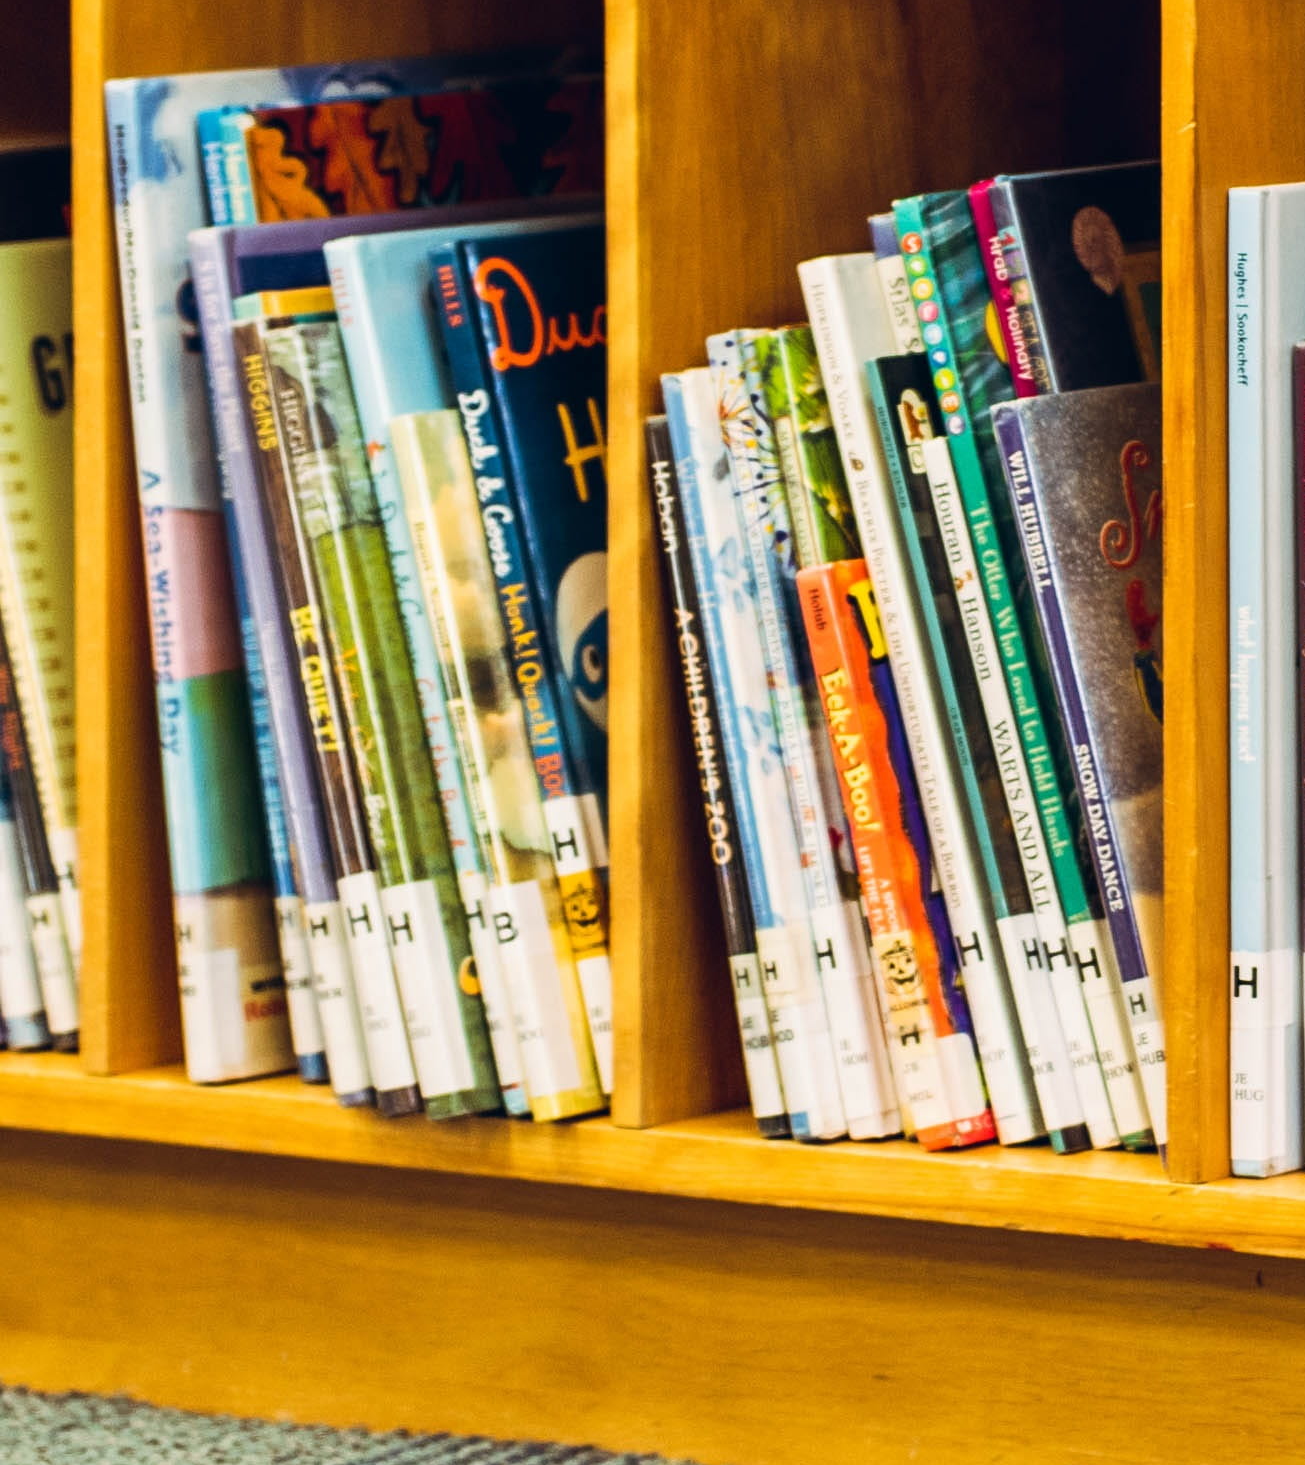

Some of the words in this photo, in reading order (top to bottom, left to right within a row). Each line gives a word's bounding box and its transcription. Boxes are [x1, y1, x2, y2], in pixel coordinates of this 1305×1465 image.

[243, 354, 275, 452] HIGGINS
[290, 604, 320, 651] BE
[302, 654, 341, 752] QUIET!
[1075, 744, 1099, 800] SNOW
[991, 718, 1024, 804] WARTS
[1008, 809, 1041, 863] AND
[1027, 868, 1055, 915] ALL
[1087, 803, 1108, 841] DAY
[1097, 844, 1124, 912] DANCE
[346, 904, 370, 936] H
[1234, 964, 1258, 999] H
